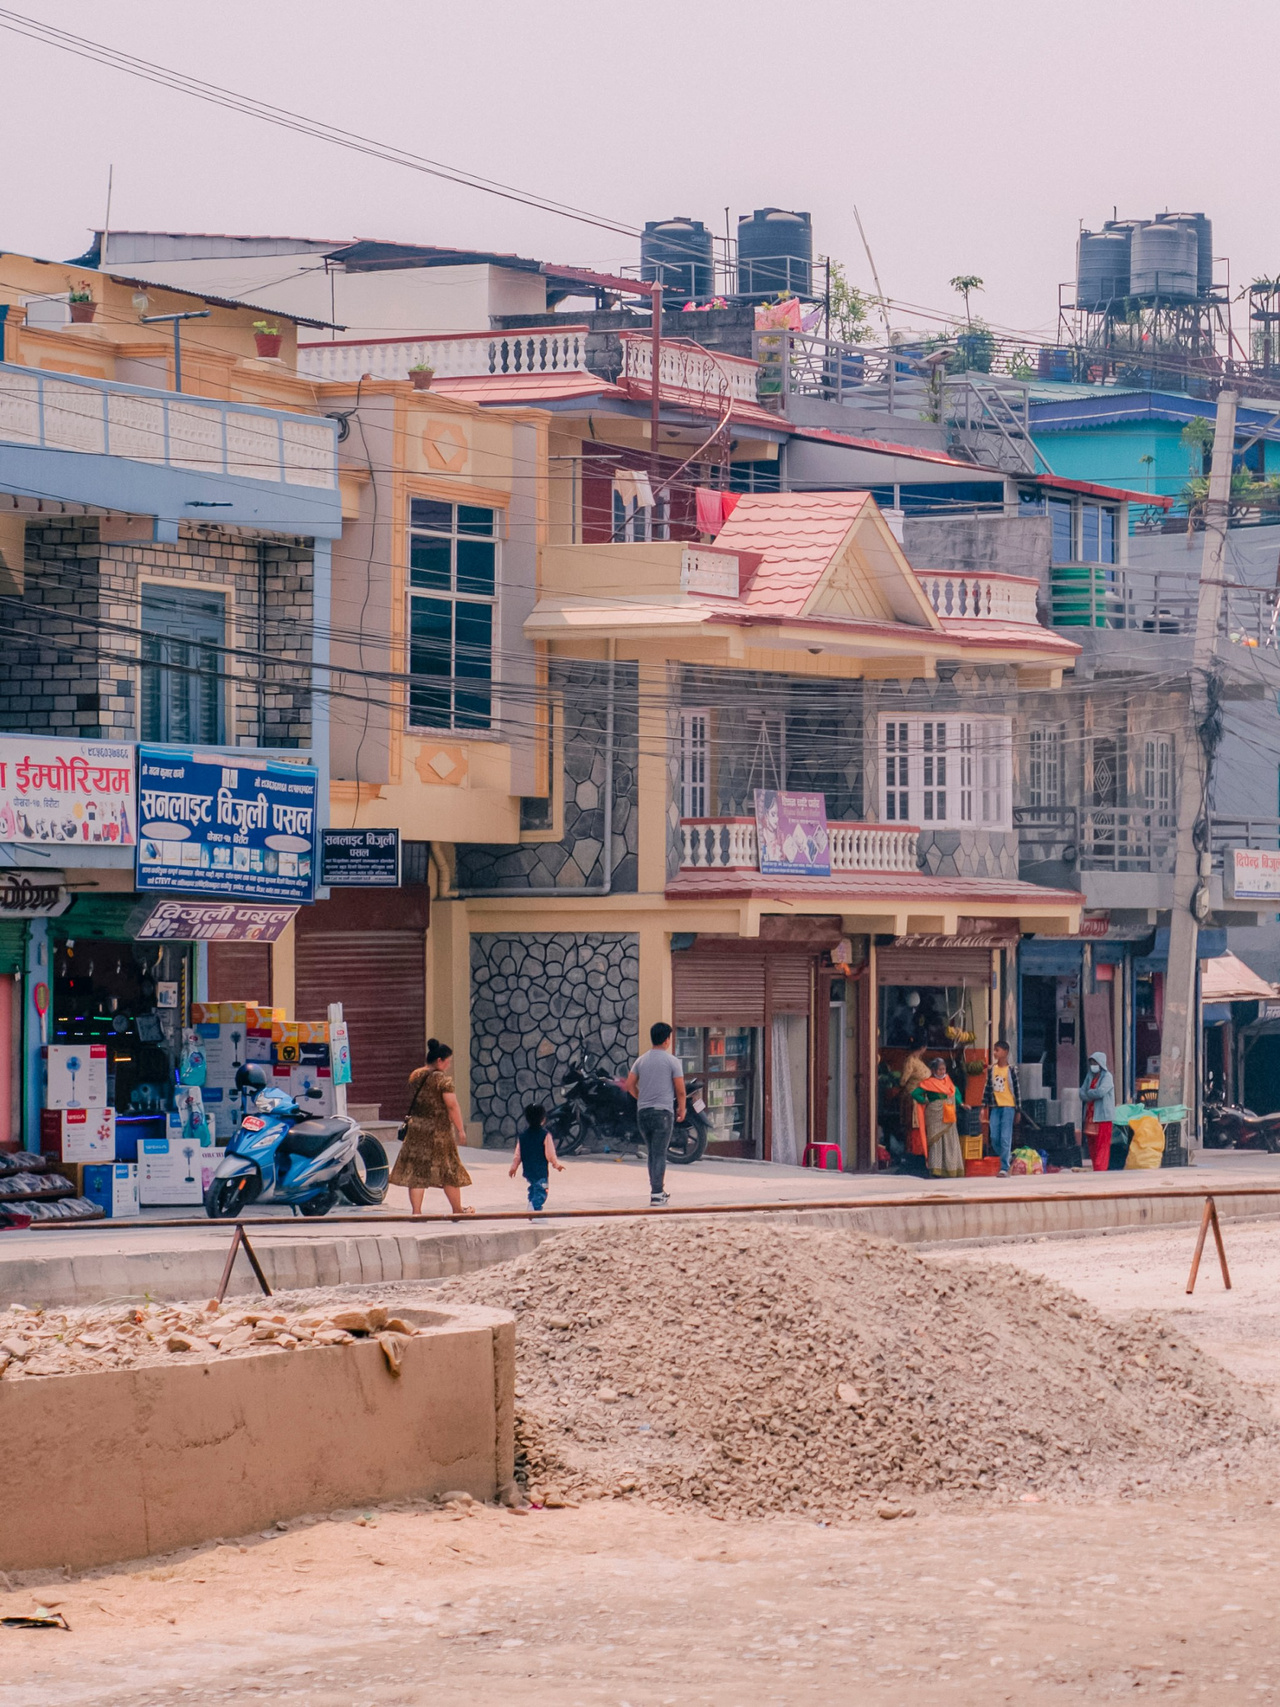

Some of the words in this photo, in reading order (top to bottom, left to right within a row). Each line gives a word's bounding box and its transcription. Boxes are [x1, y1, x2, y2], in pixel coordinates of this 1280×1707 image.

[15, 755, 131, 794] ईम्पोरियम
[141, 789, 214, 827] सनलाइट
[272, 803, 313, 835] पसल
[324, 835, 364, 847] सनलाइट
[349, 848, 369, 857] पसल
